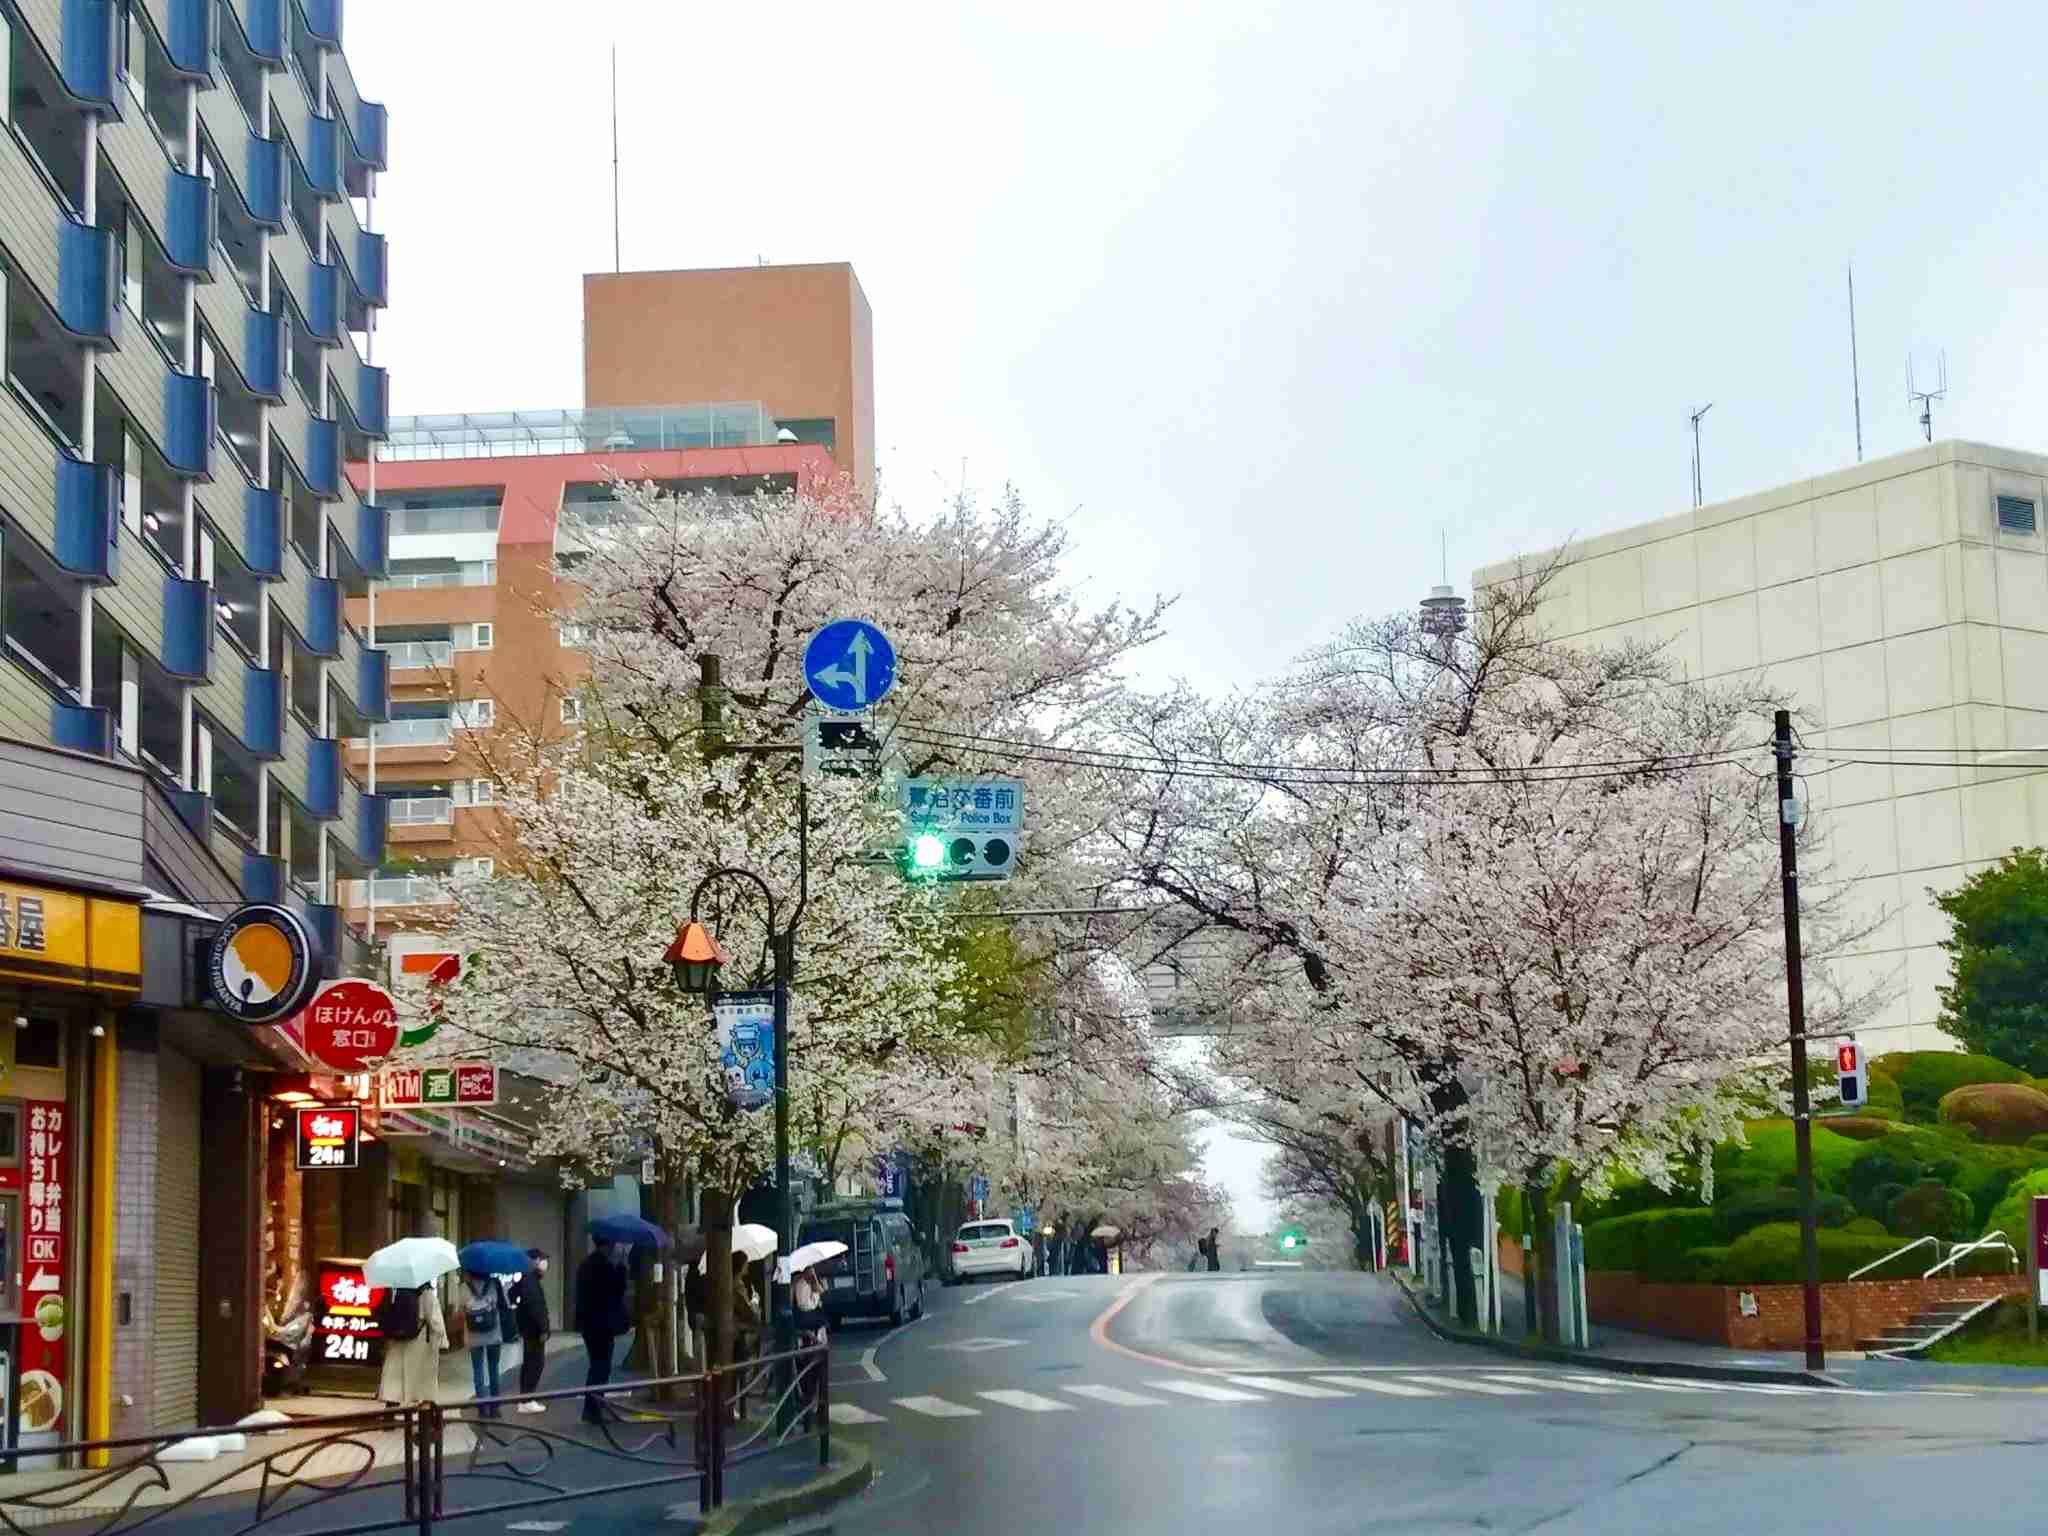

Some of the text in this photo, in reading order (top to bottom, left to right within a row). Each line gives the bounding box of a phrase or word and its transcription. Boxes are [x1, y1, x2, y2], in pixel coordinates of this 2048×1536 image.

[993, 813, 1011, 824] Box
[314, 1006, 391, 1026] ほけんの
[332, 1029, 369, 1048] 窓口
[389, 1072, 419, 1098] ATM
[429, 1073, 450, 1097] 酒
[309, 1145, 345, 1165] 24H
[29, 1105, 46, 1233] お持ち帰り
[45, 1107, 62, 1233] カレー弁当
[32, 1239, 55, 1259] OK
[324, 1333, 369, 1360] 24H
